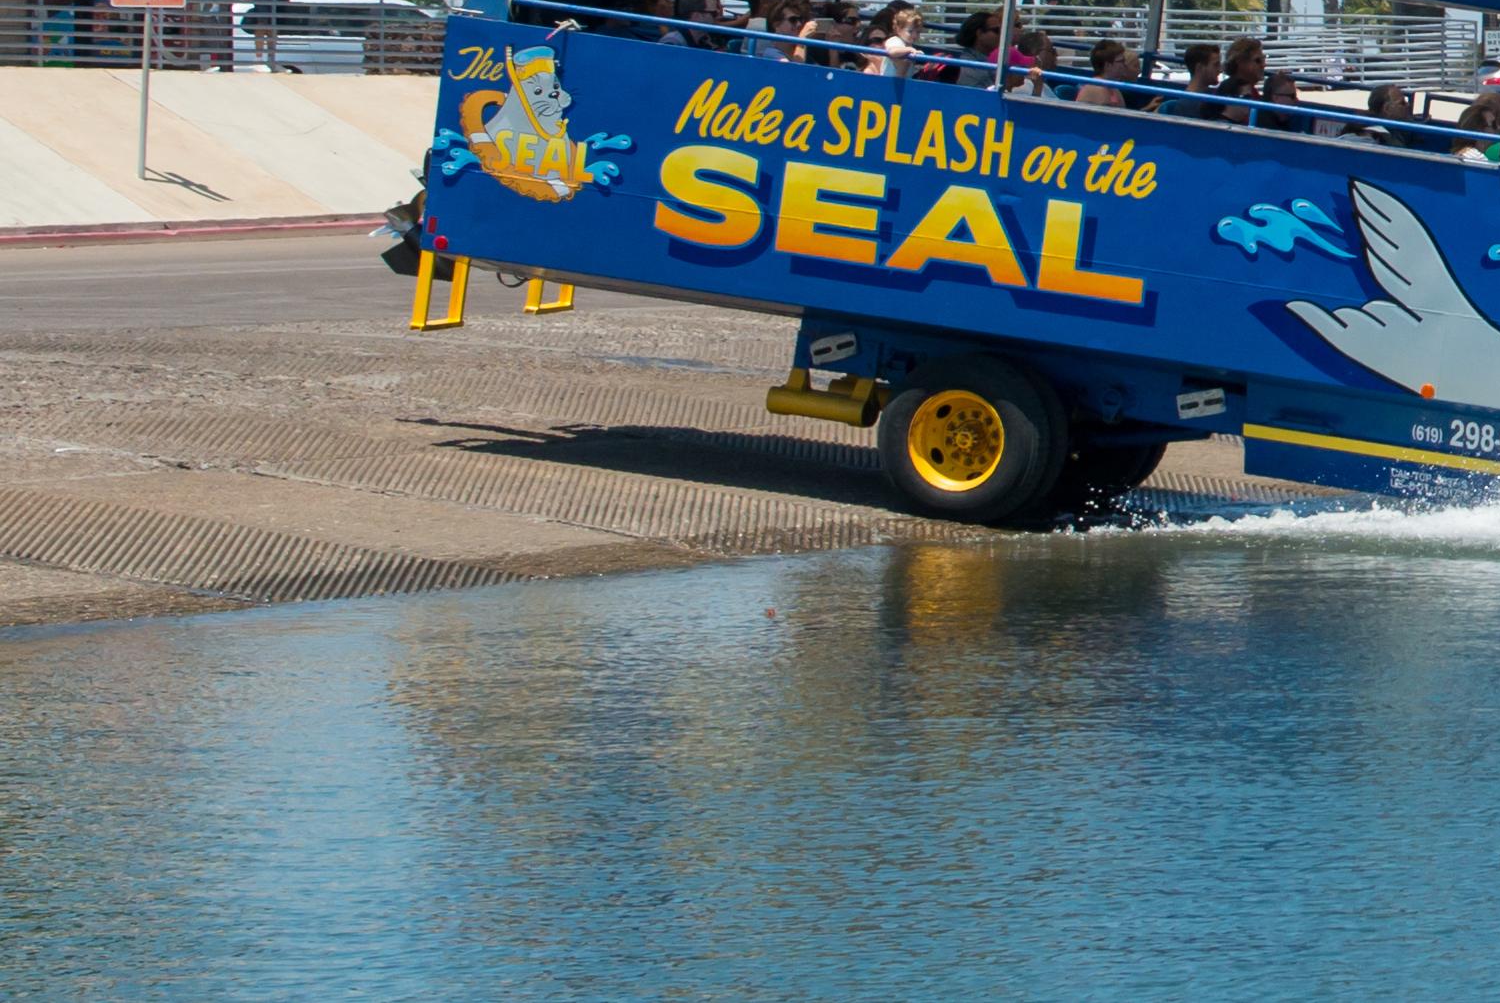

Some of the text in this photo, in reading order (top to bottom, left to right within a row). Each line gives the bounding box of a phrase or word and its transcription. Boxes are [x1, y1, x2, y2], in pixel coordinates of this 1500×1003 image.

[448, 46, 504, 81] The
[493, 130, 594, 183] SEAL
[675, 78, 1158, 199] Make a SPLASH on the
[654, 145, 1145, 305] SEAL
[1412, 424, 1443, 444] (619)
